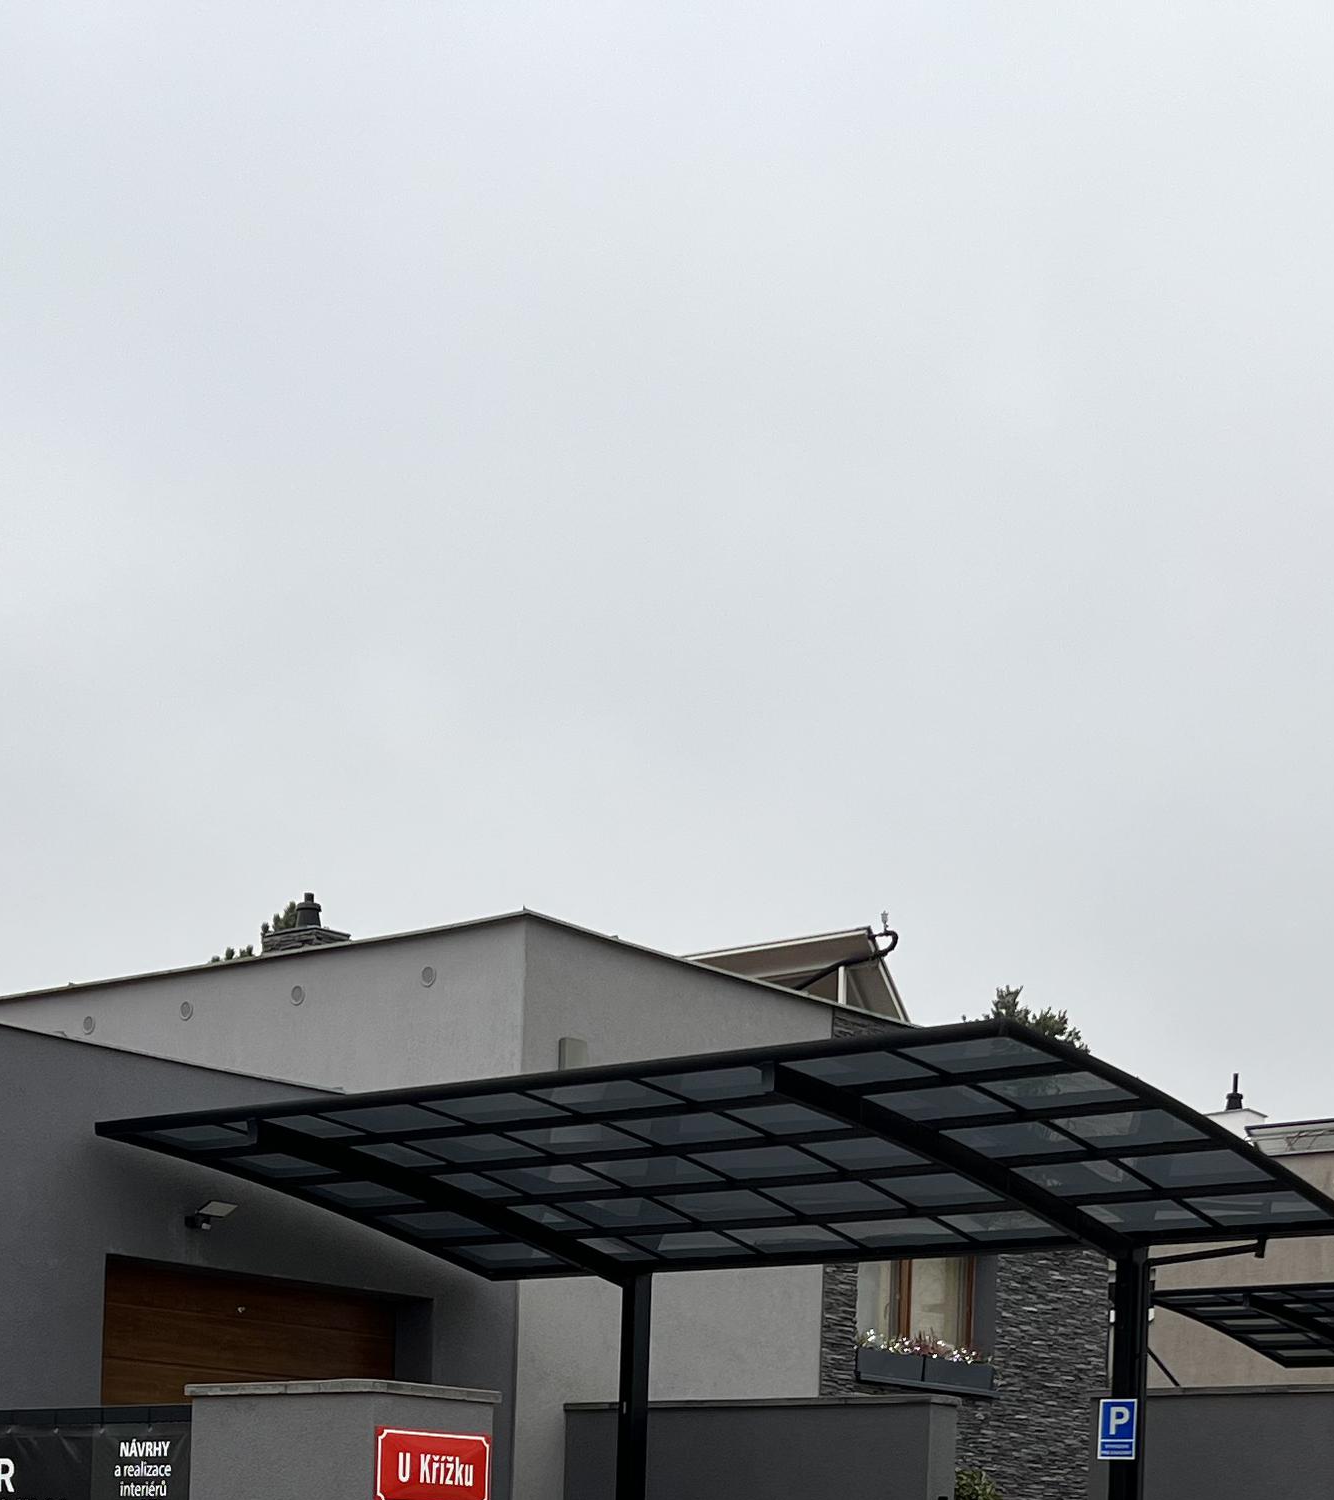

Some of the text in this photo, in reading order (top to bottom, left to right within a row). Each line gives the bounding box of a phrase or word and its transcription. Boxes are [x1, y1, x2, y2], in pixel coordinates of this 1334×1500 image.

[1109, 1406, 1130, 1435] P
[119, 1438, 171, 1458] NÁVRHY
[114, 1461, 172, 1477] a realizace
[398, 1452, 474, 1487] U Křížku
[119, 1480, 167, 1497] interiérů
